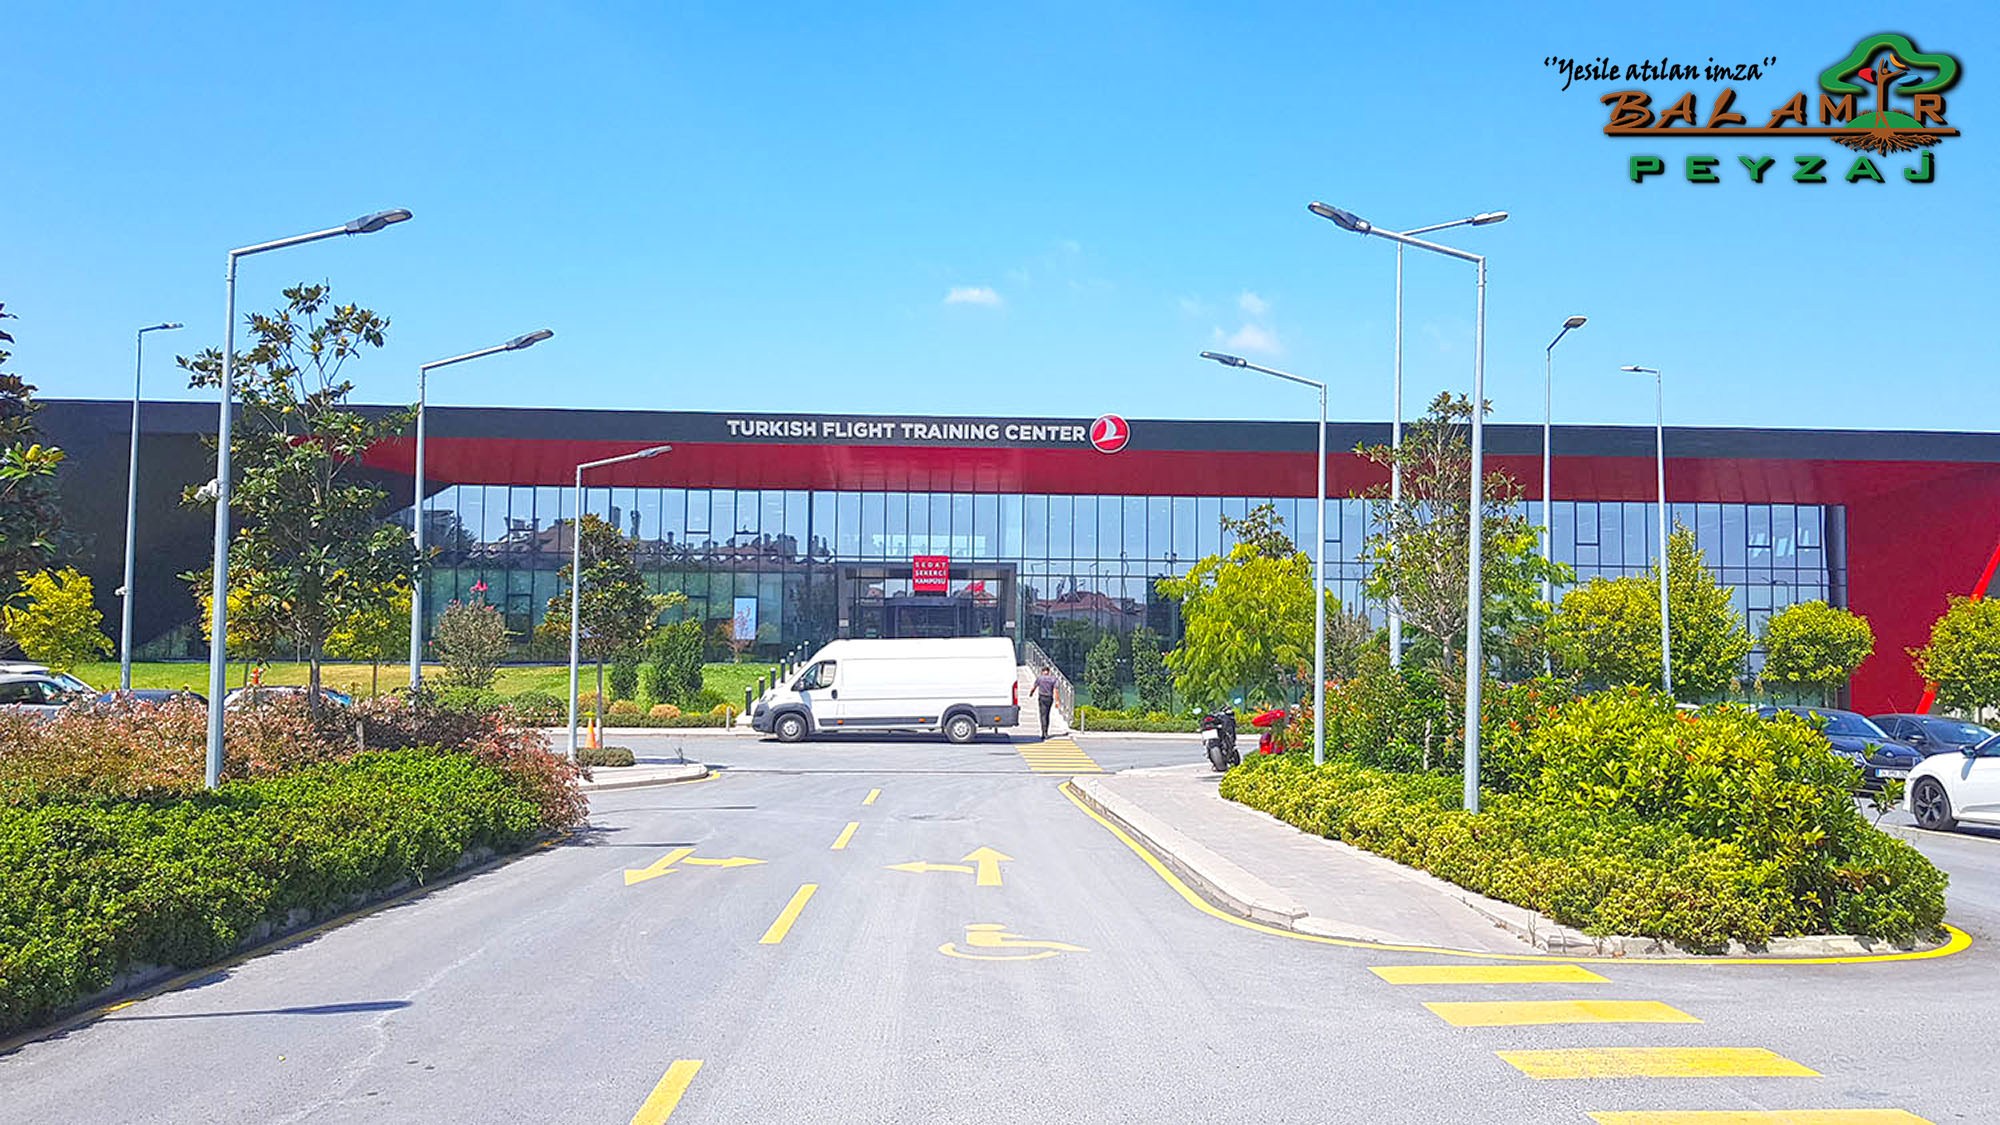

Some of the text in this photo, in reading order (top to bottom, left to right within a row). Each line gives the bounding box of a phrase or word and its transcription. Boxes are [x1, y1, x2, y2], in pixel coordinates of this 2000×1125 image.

[727, 420, 1087, 442] TURKISH FLIGHT TRAINING CENTER
